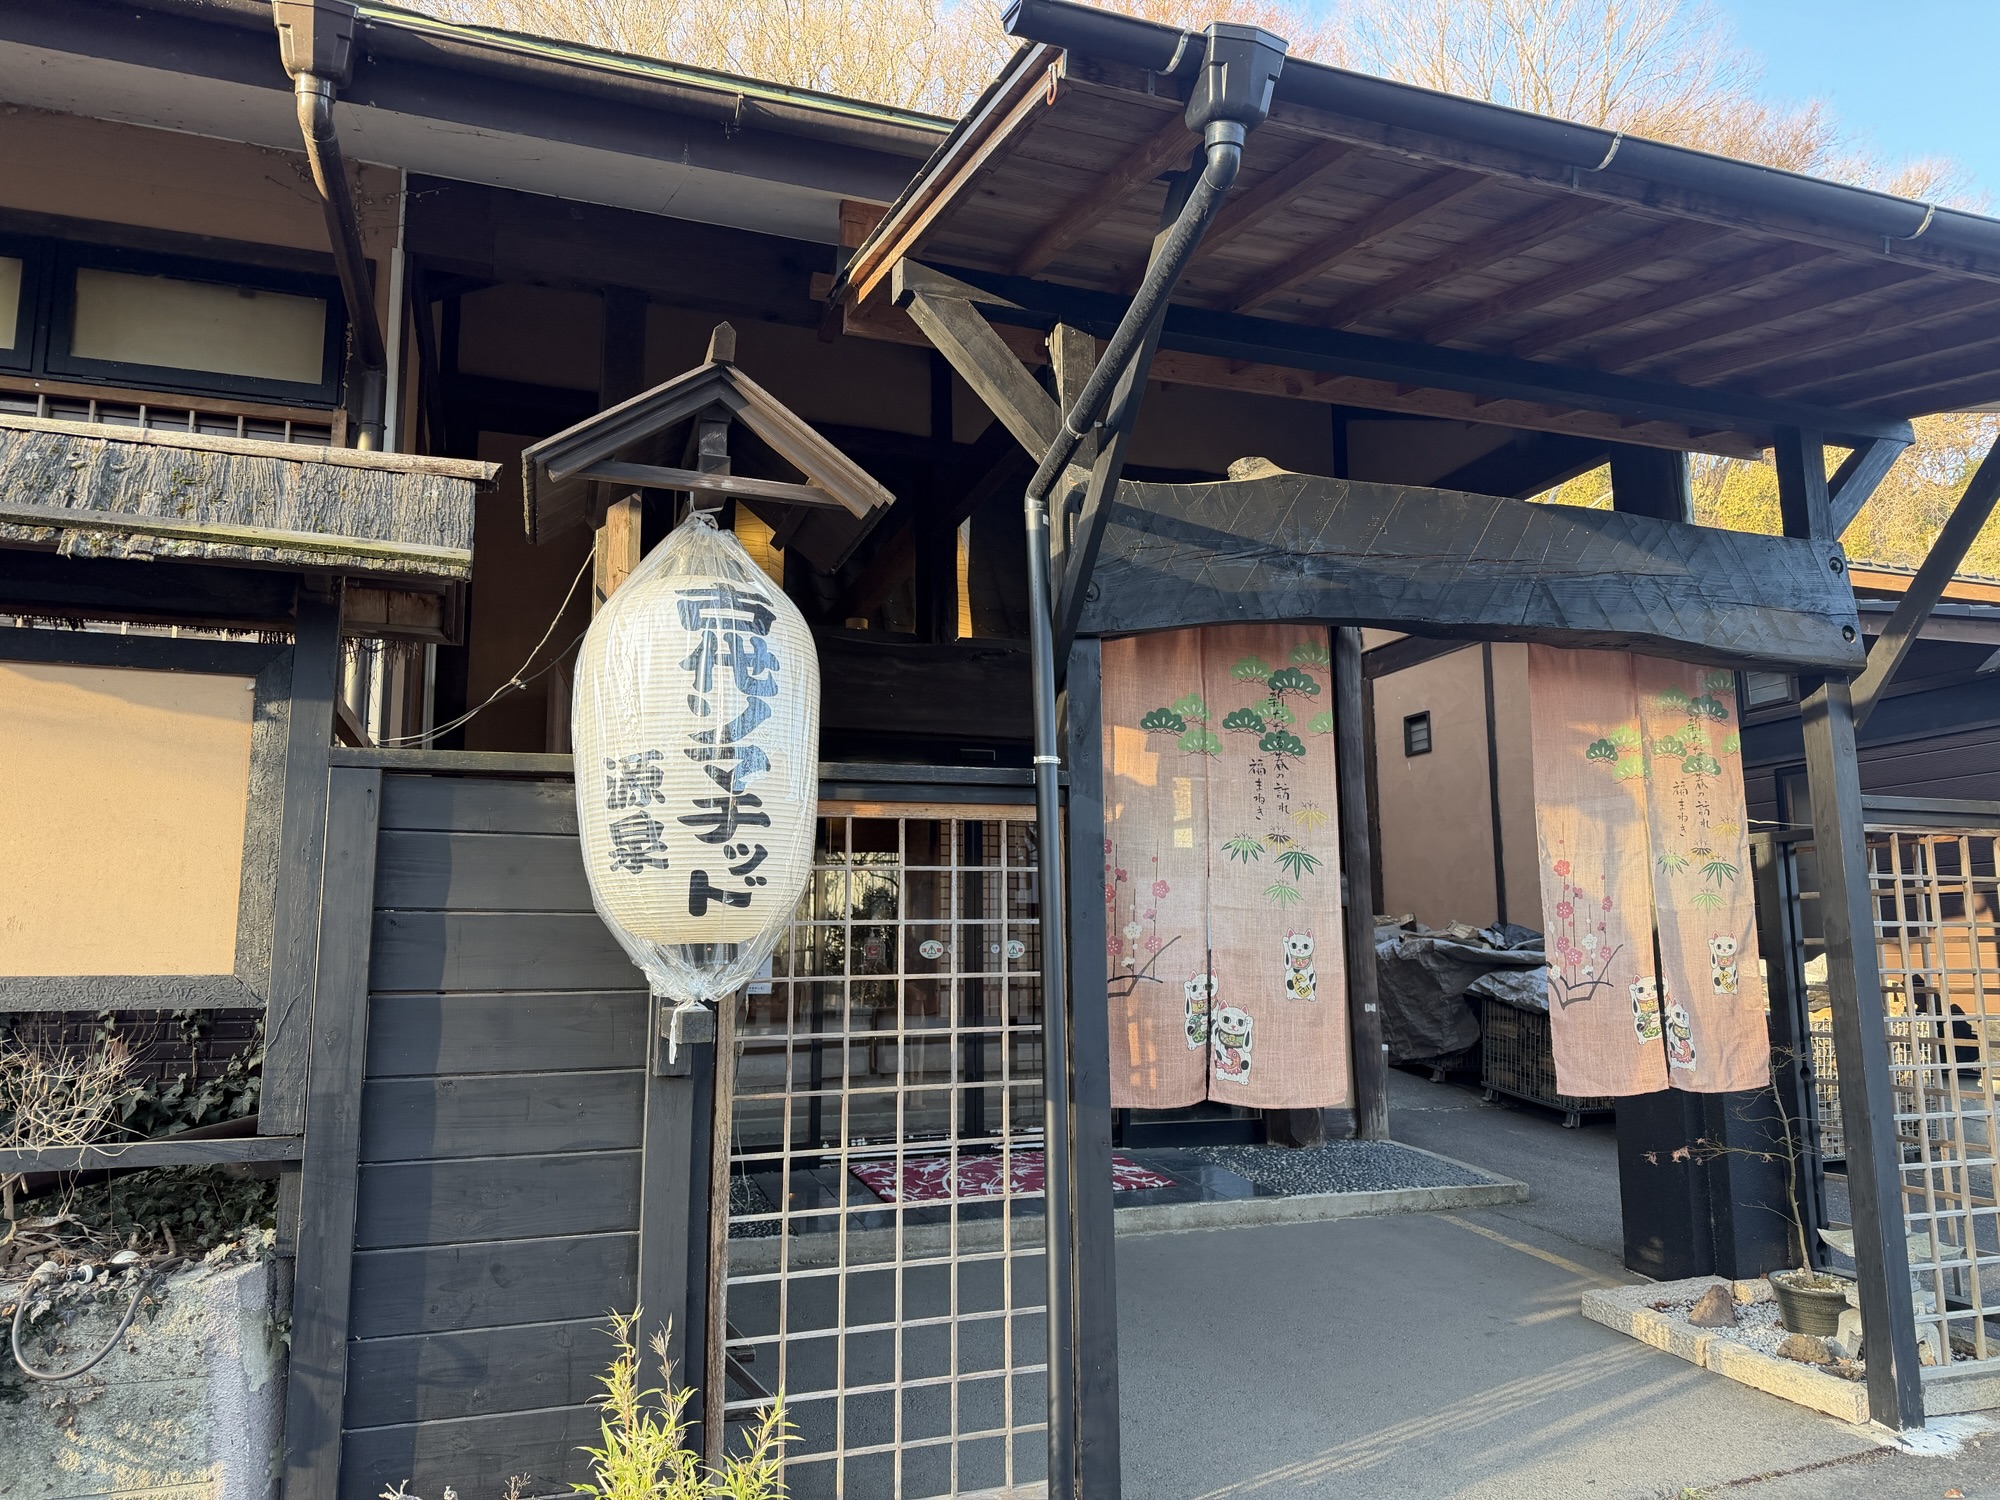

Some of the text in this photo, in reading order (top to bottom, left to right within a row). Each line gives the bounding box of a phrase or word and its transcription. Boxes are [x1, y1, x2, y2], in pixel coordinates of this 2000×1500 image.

[674, 583, 780, 917] 古代ソマチッド
[1248, 759, 1266, 821] 福まねき
[603, 749, 669, 875] 源泉
[1673, 780, 1689, 837] 福まねき
